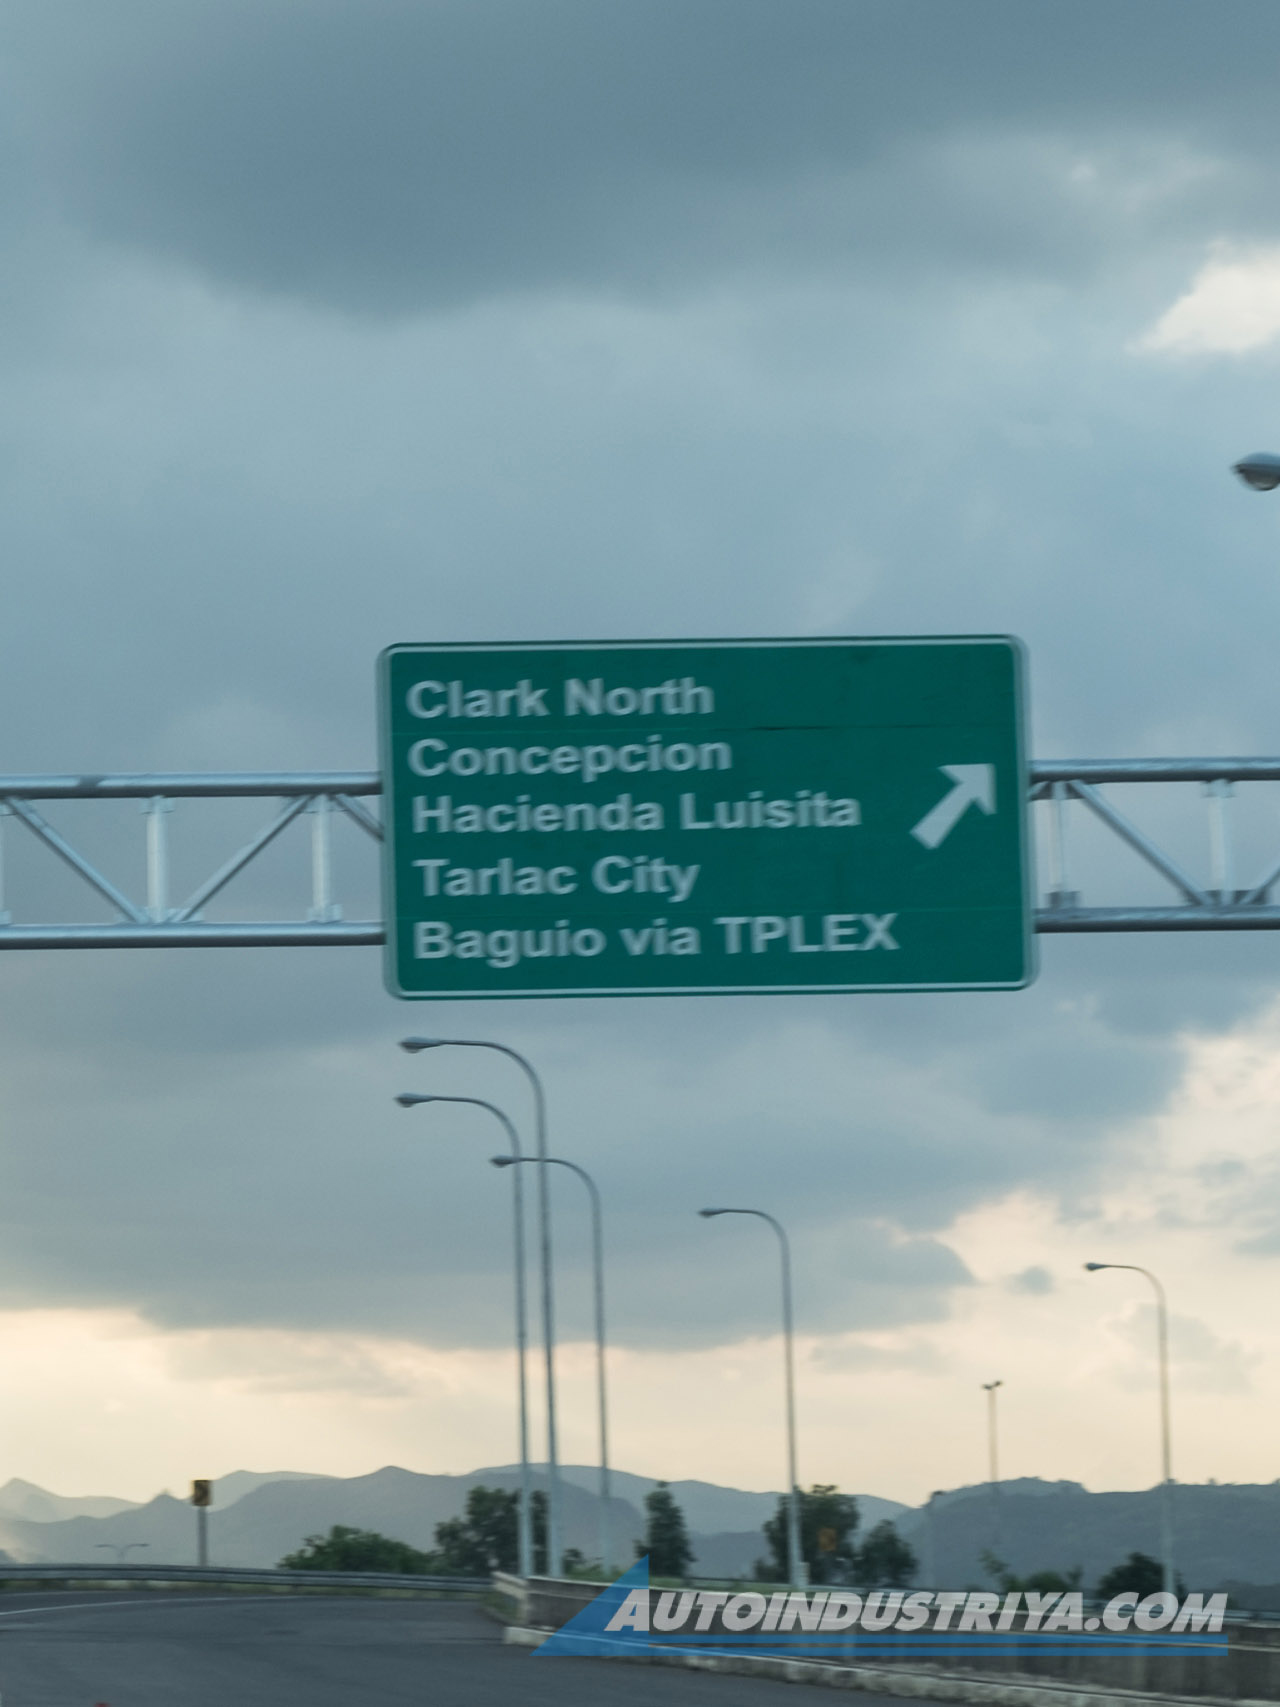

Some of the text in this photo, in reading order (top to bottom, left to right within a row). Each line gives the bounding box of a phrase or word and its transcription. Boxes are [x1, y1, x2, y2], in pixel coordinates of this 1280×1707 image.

[406, 676, 715, 719] Clark North
[407, 734, 732, 783] Concepcion
[412, 790, 861, 834] Hacienda Luisita
[413, 855, 700, 902] Tarlac City
[413, 913, 900, 968] Baguio via TPLEX
